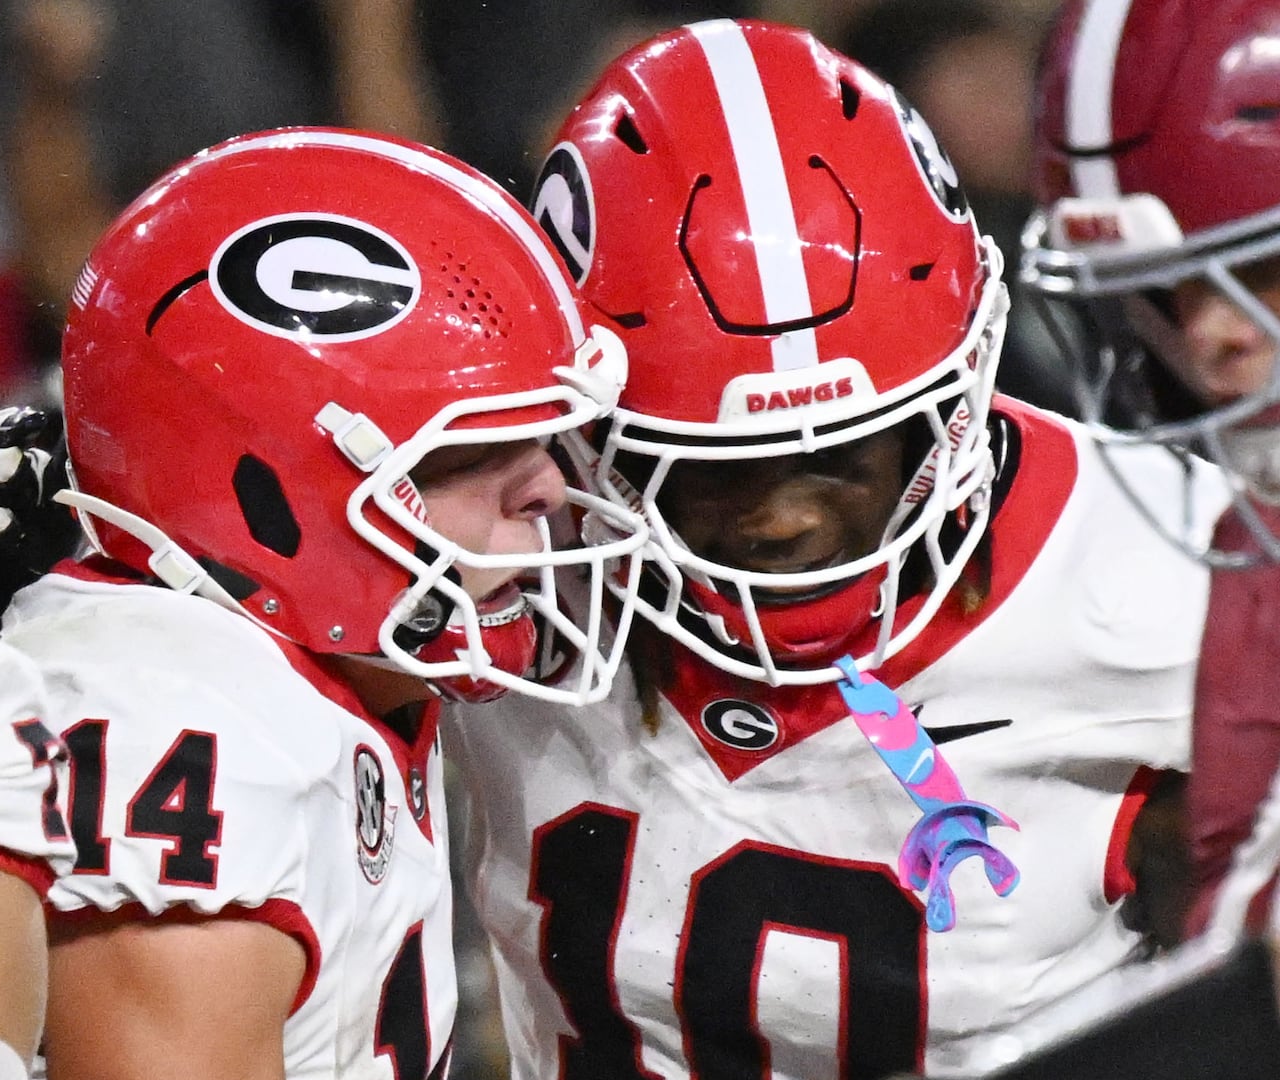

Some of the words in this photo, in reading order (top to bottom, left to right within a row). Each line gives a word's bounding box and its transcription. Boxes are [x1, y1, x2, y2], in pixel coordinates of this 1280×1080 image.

[209, 212, 421, 343] G
[745, 376, 854, 414] DAWGS
[701, 698, 779, 751] G
[60, 718, 225, 890] 14
